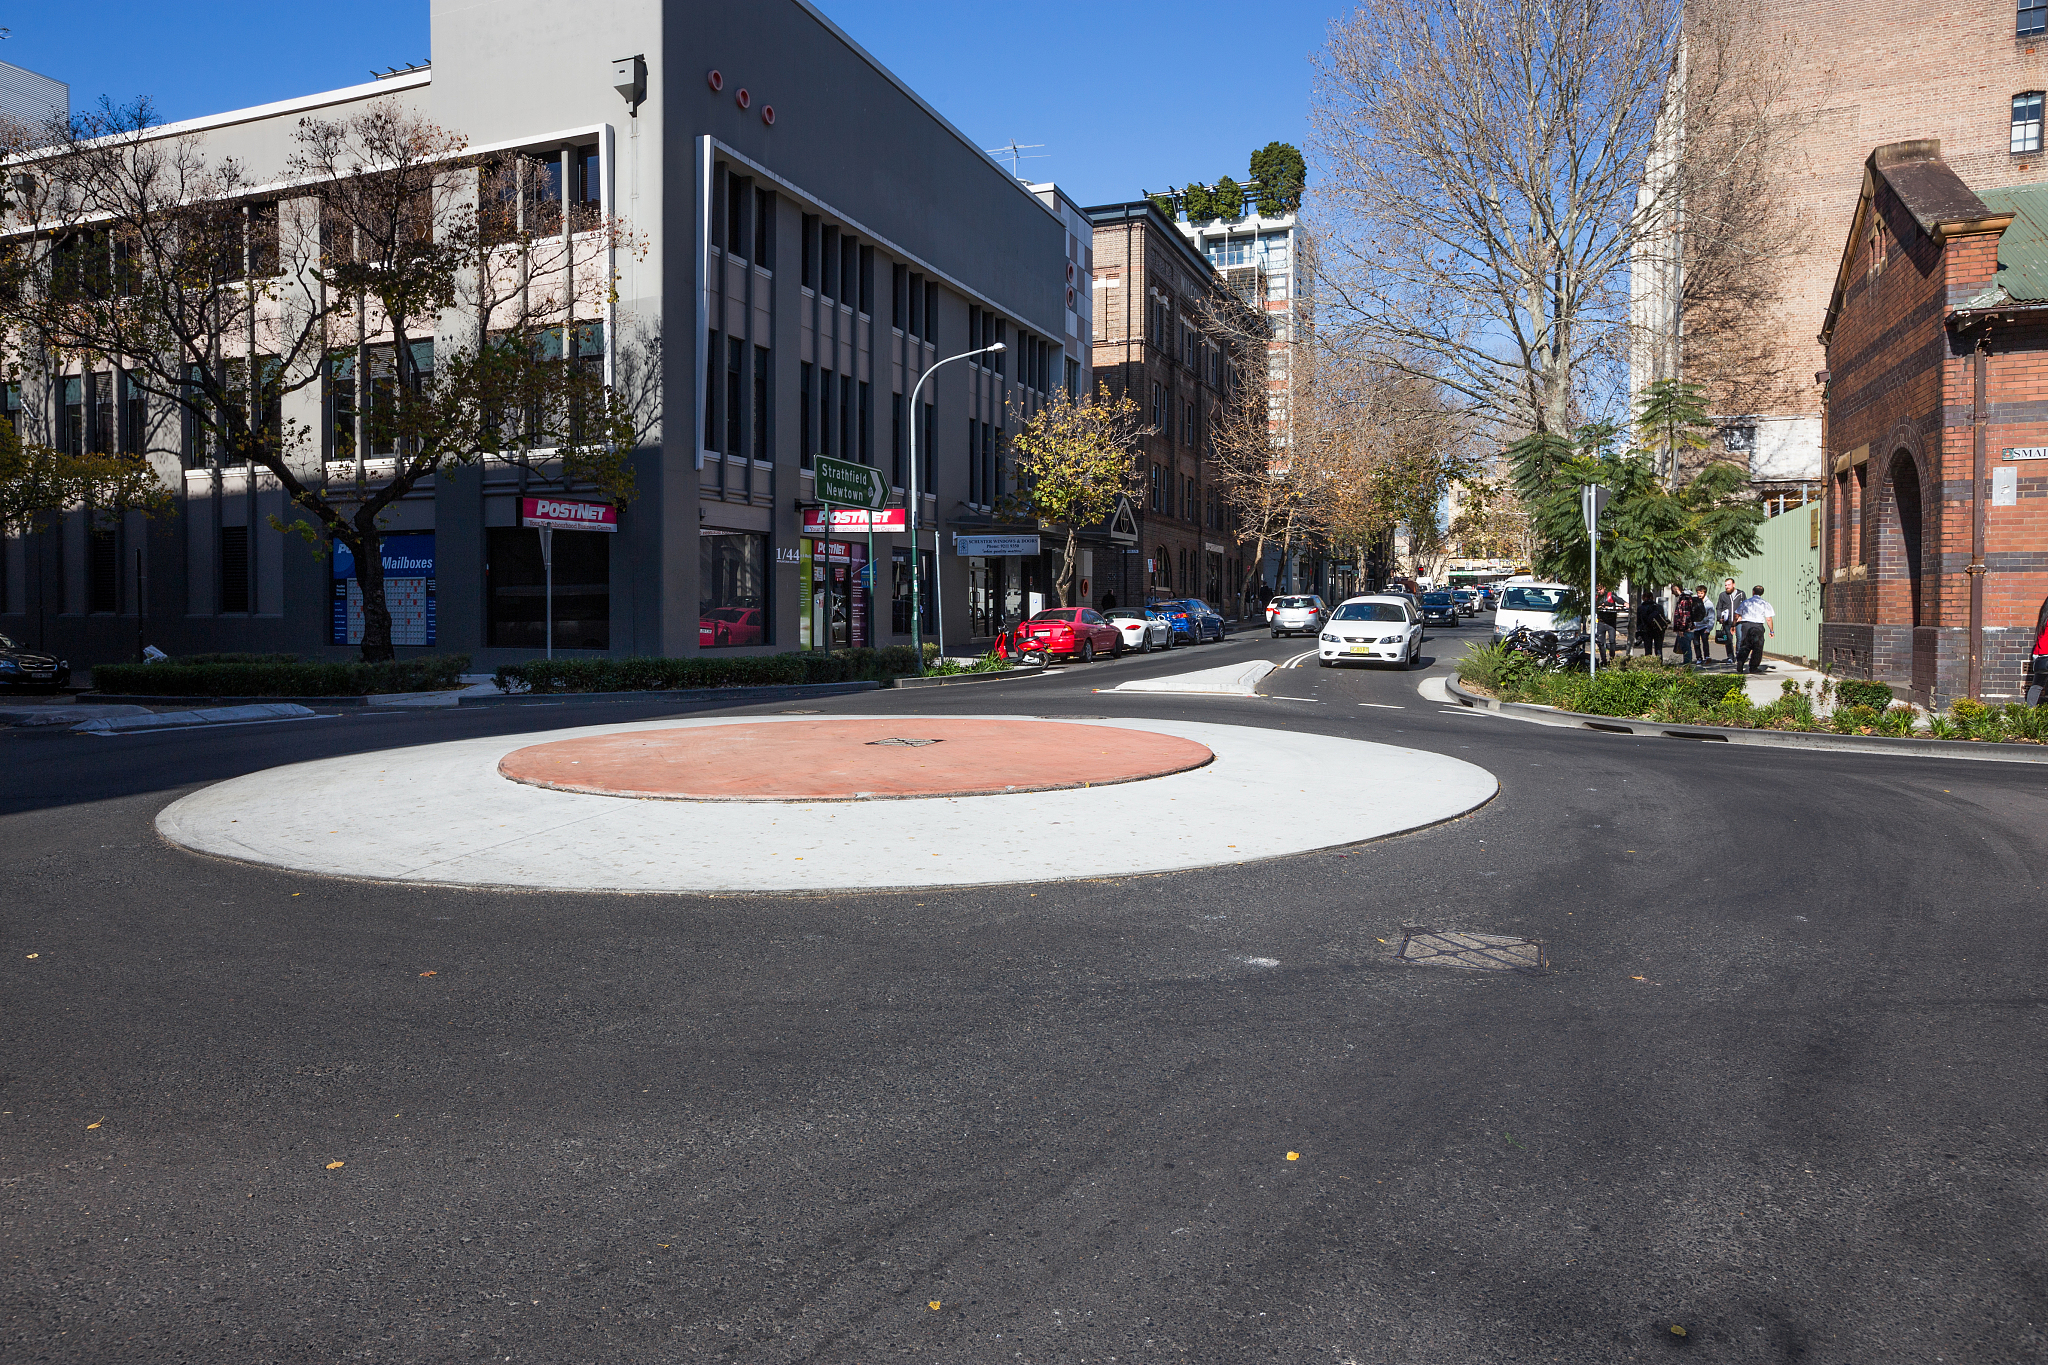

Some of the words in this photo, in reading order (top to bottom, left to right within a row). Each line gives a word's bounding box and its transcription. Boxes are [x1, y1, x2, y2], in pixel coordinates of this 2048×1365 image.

[822, 463, 867, 486] Strathfield
[826, 482, 864, 502] Newtown
[578, 523, 596, 531] Business
[776, 547, 800, 561] 1/44
[381, 556, 433, 570] Mailboxes
